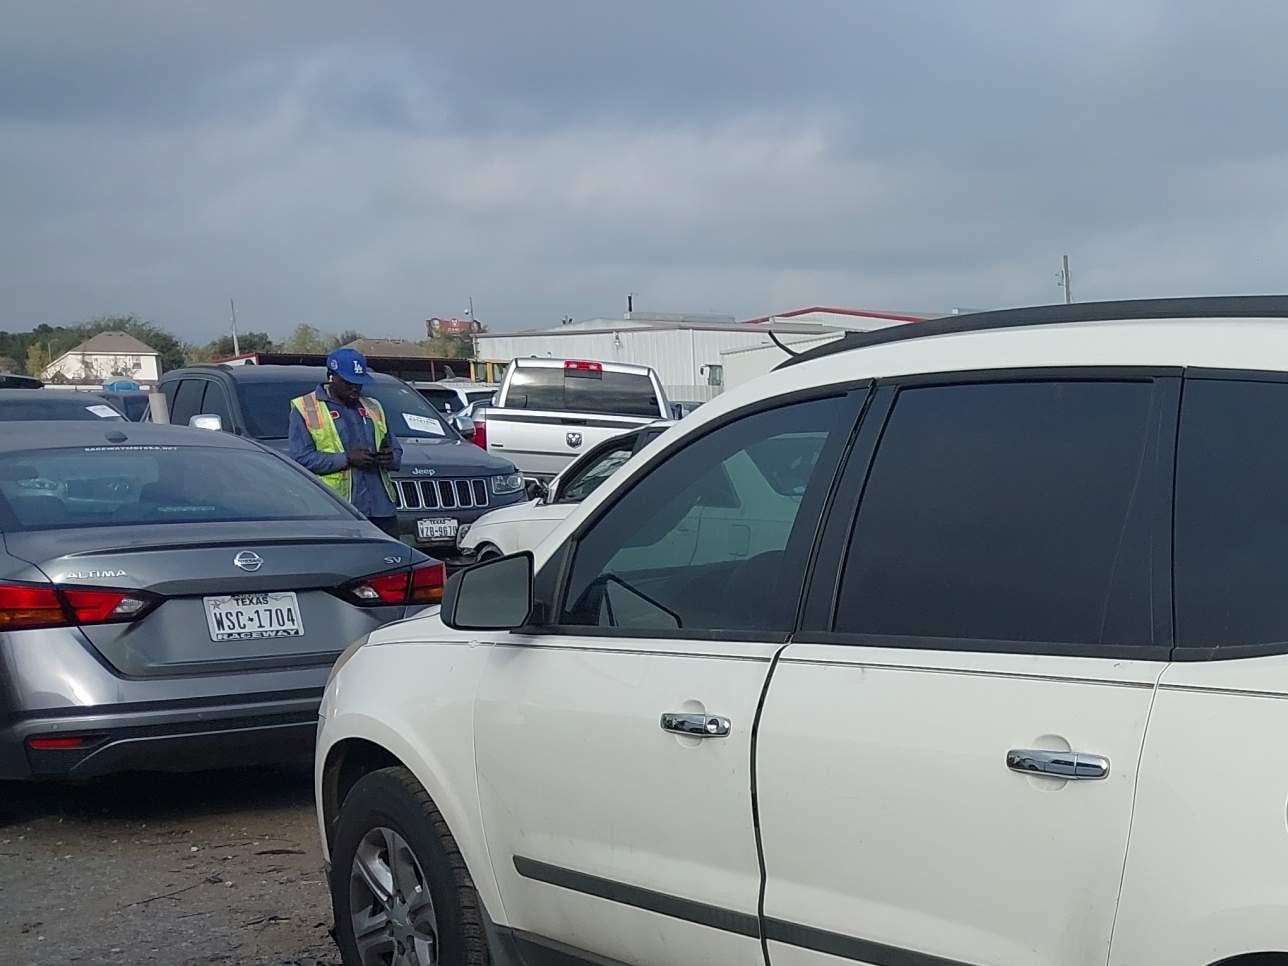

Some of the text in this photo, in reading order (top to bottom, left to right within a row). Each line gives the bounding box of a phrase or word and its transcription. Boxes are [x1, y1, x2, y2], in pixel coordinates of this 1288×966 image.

[411, 467, 436, 476] Jeep
[66, 569, 127, 578] ALTIMA
[234, 596, 269, 606] TEXAS
[217, 629, 299, 640] RACEWAY
